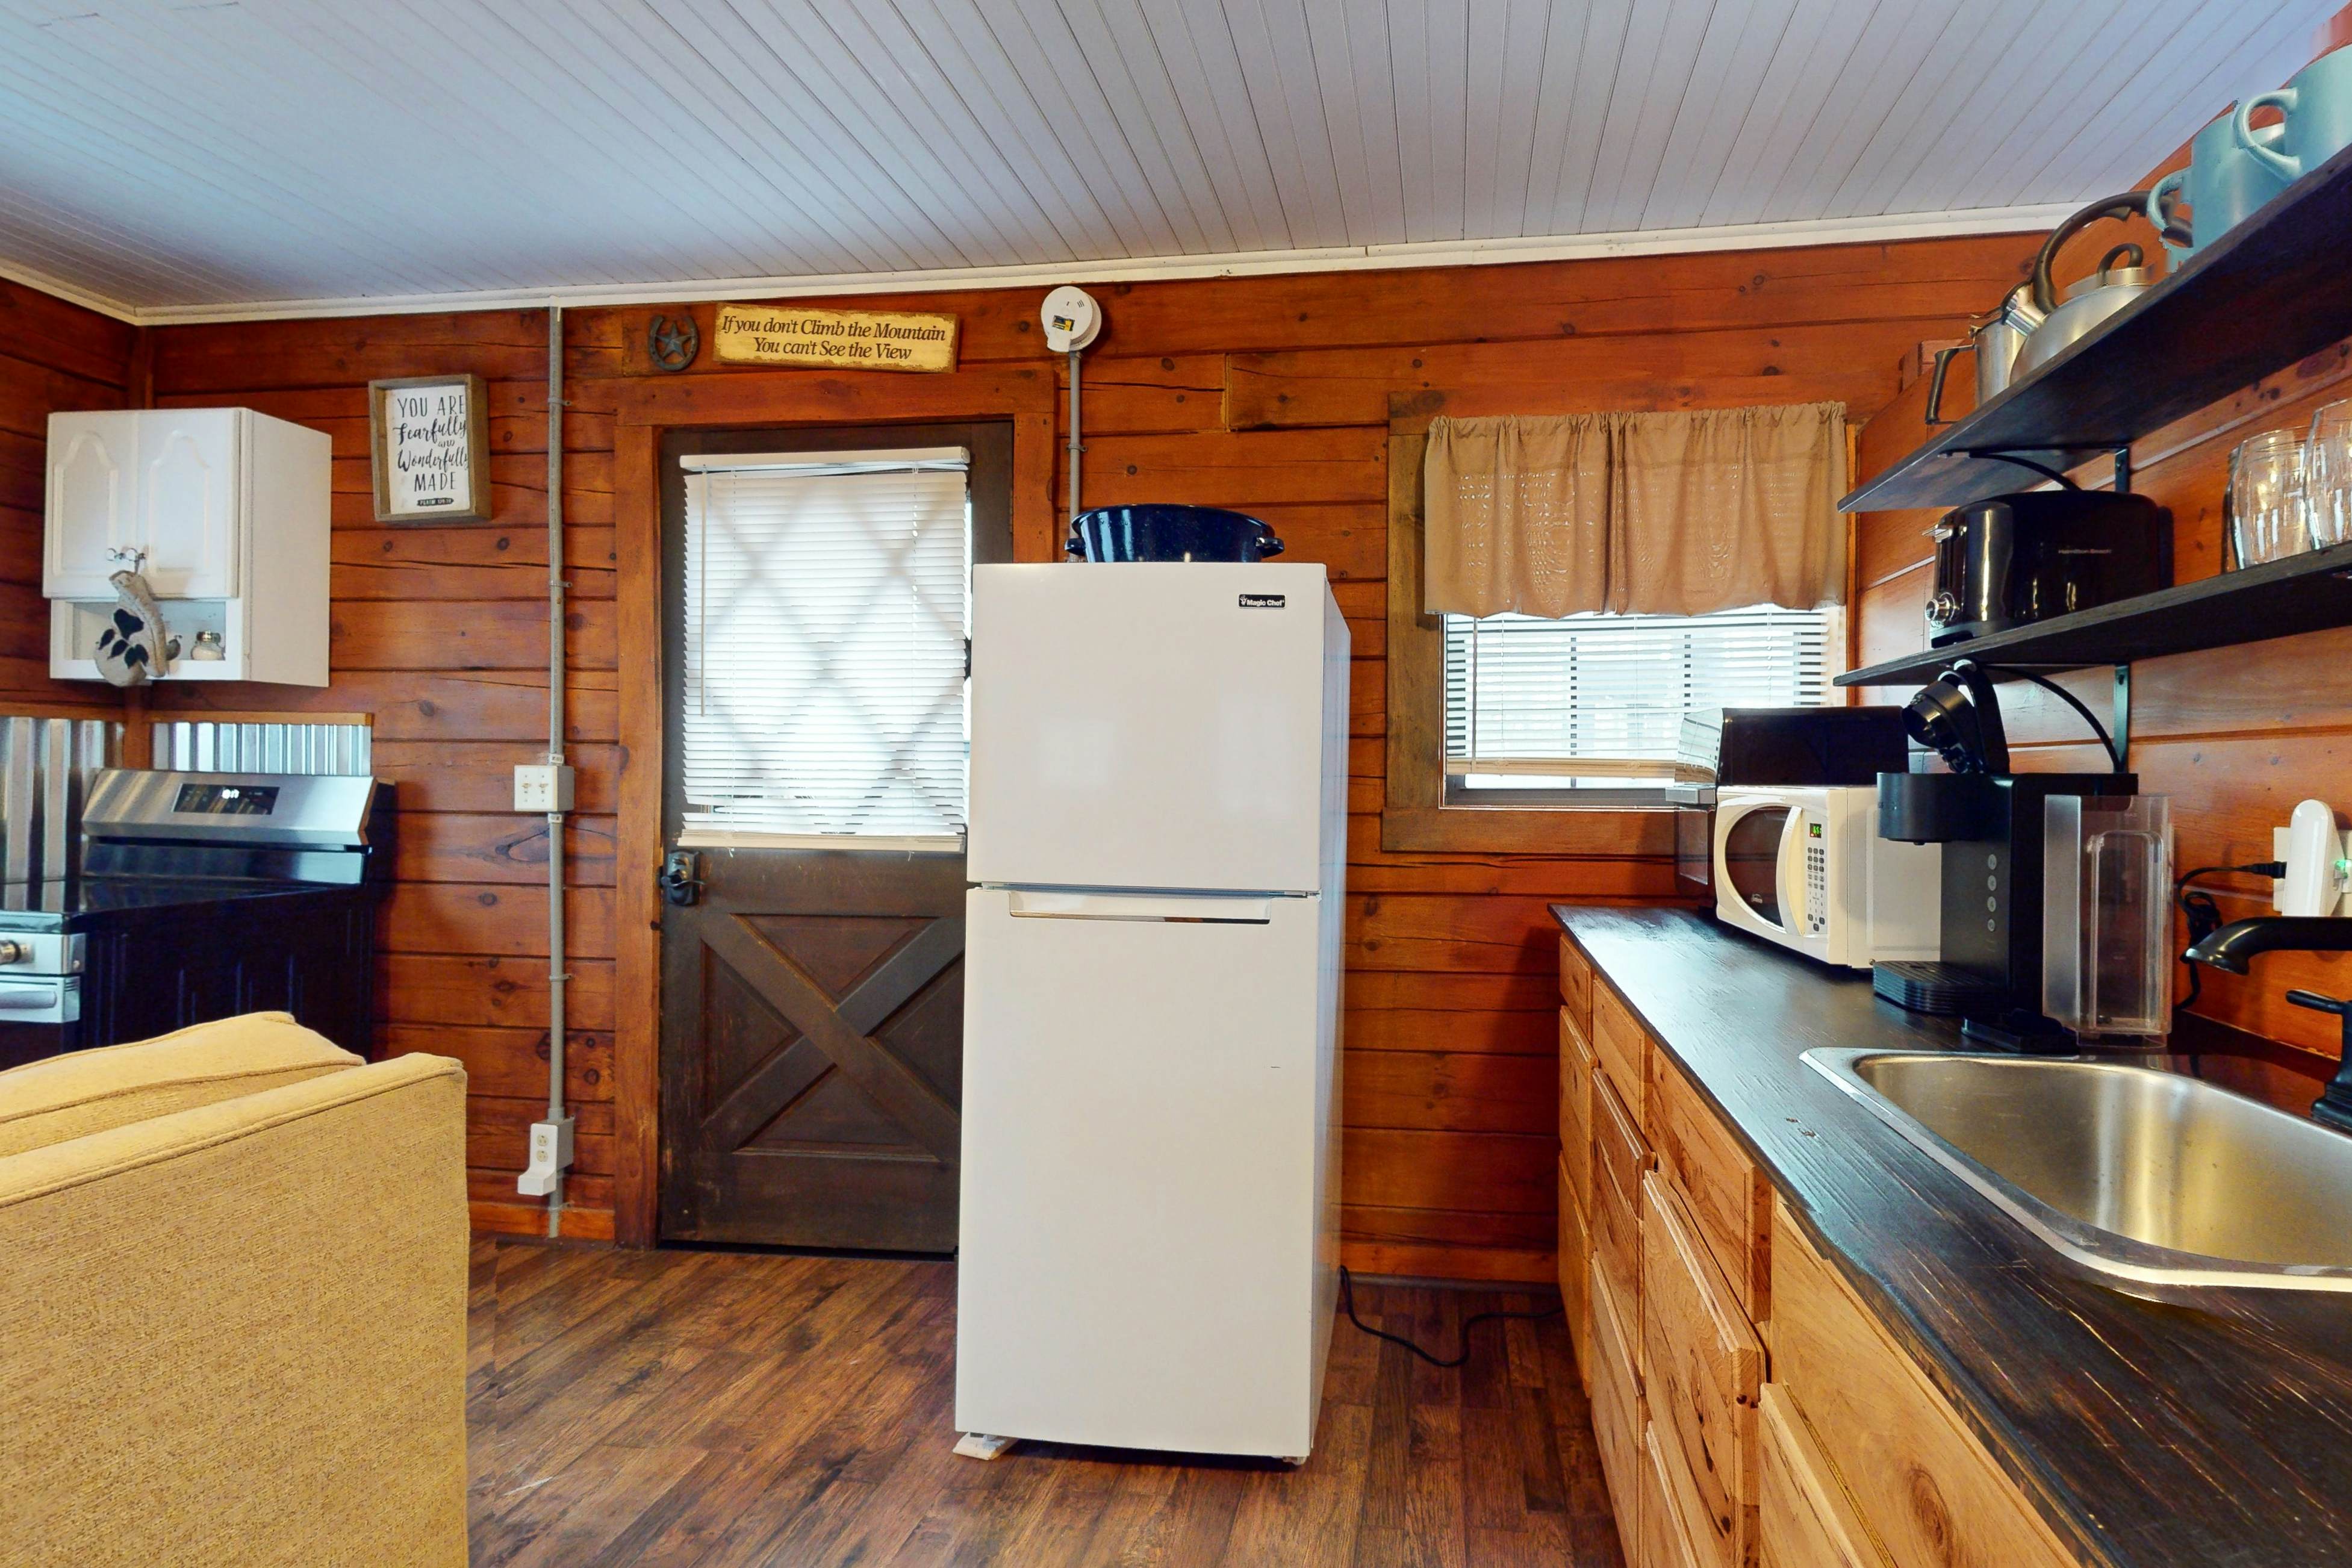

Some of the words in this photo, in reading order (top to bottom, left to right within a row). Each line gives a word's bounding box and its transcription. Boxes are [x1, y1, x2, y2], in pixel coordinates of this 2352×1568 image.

[722, 316, 736, 334] If
[734, 320, 761, 334] you
[763, 317, 799, 334] don't
[801, 319, 844, 337] Climb
[847, 322, 872, 338] the
[873, 323, 946, 341] Mountain
[753, 337, 780, 353] You
[783, 340, 818, 355] can't
[819, 340, 846, 357] See
[848, 342, 873, 358] the
[876, 343, 912, 359] View
[397, 397, 428, 418] YOU
[437, 395, 464, 415] ARE
[414, 471, 456, 492] MADE
